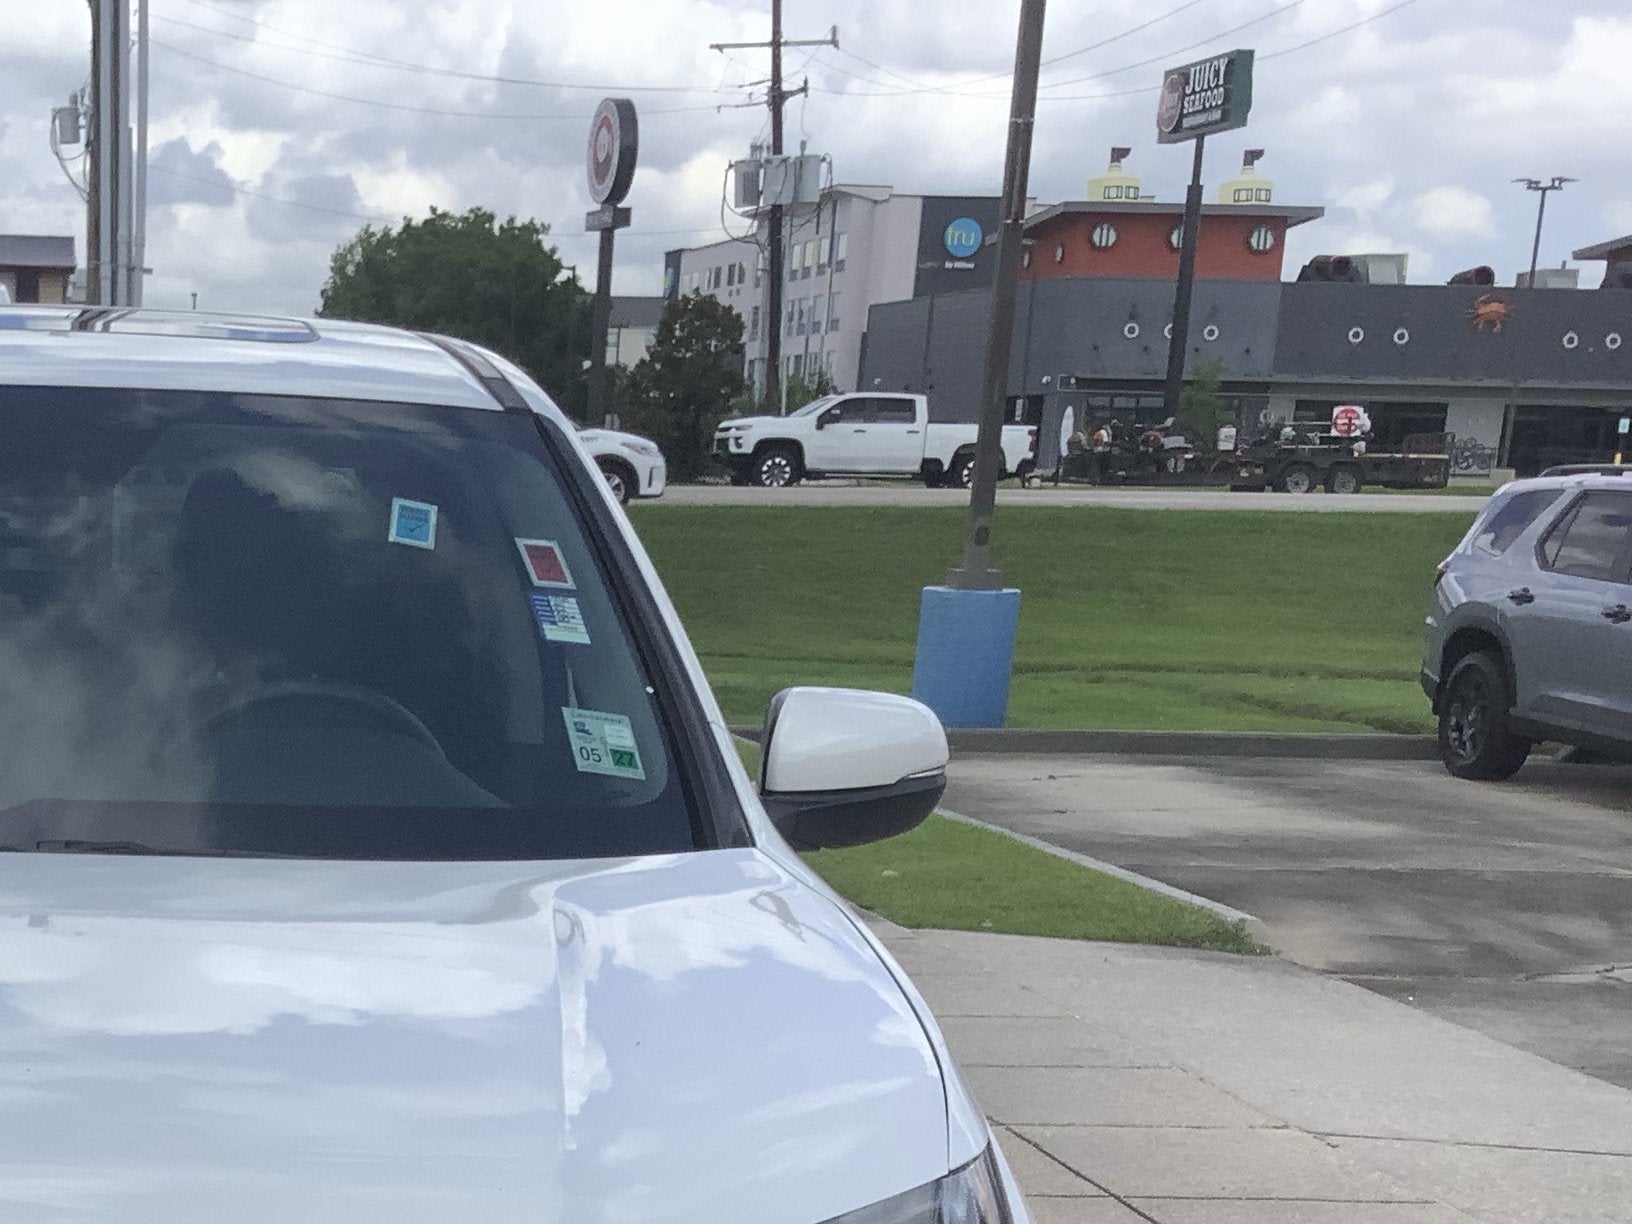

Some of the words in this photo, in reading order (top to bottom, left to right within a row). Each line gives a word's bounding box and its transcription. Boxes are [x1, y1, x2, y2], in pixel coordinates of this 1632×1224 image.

[1185, 57, 1228, 95] JUICY
[1183, 86, 1225, 114] SEAFOOD
[579, 746, 602, 763] 05
[613, 750, 635, 768] 27
